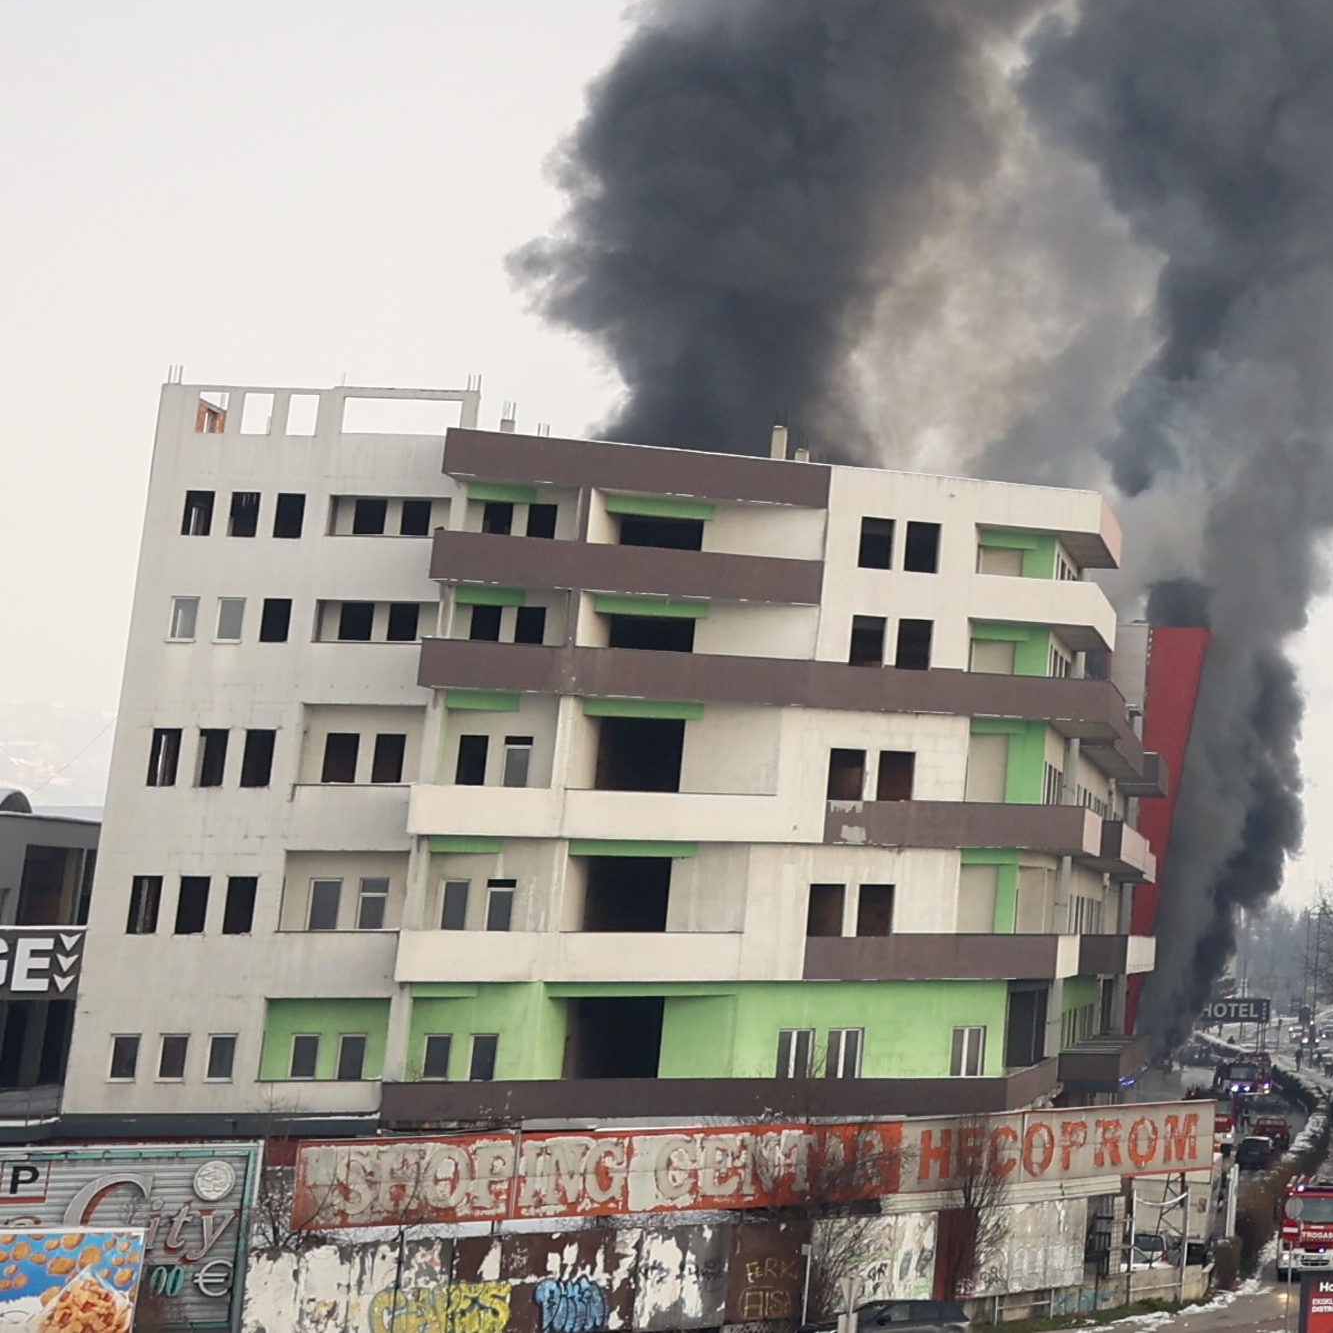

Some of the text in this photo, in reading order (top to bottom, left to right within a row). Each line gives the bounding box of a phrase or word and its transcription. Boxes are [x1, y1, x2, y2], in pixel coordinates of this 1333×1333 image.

[0, 937, 55, 991] E
[1203, 1003, 1259, 1017] HOTEL
[9, 1165, 40, 1195] P
[338, 1136, 627, 1215] SHOPING
[63, 1173, 238, 1263] City
